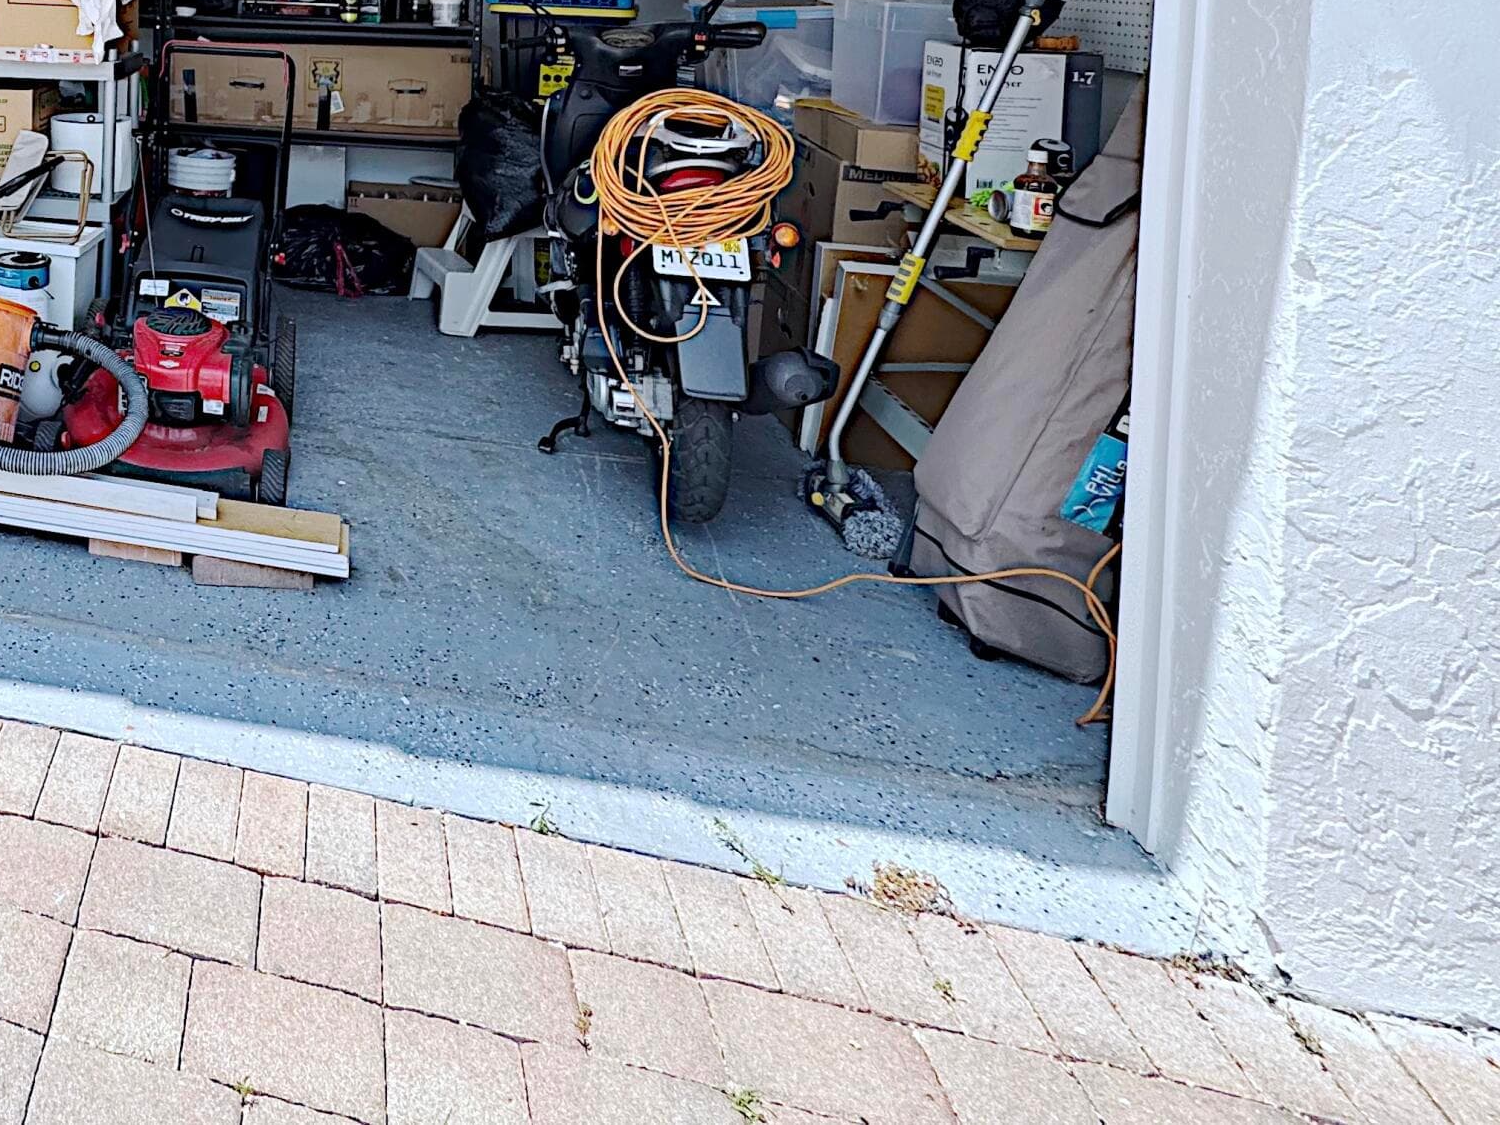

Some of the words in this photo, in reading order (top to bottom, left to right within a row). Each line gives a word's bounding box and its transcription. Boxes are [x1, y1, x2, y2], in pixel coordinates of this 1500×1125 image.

[977, 64, 1024, 75] ENO
[1071, 71, 1096, 85] 1.7
[1085, 464, 1111, 495] PHI
